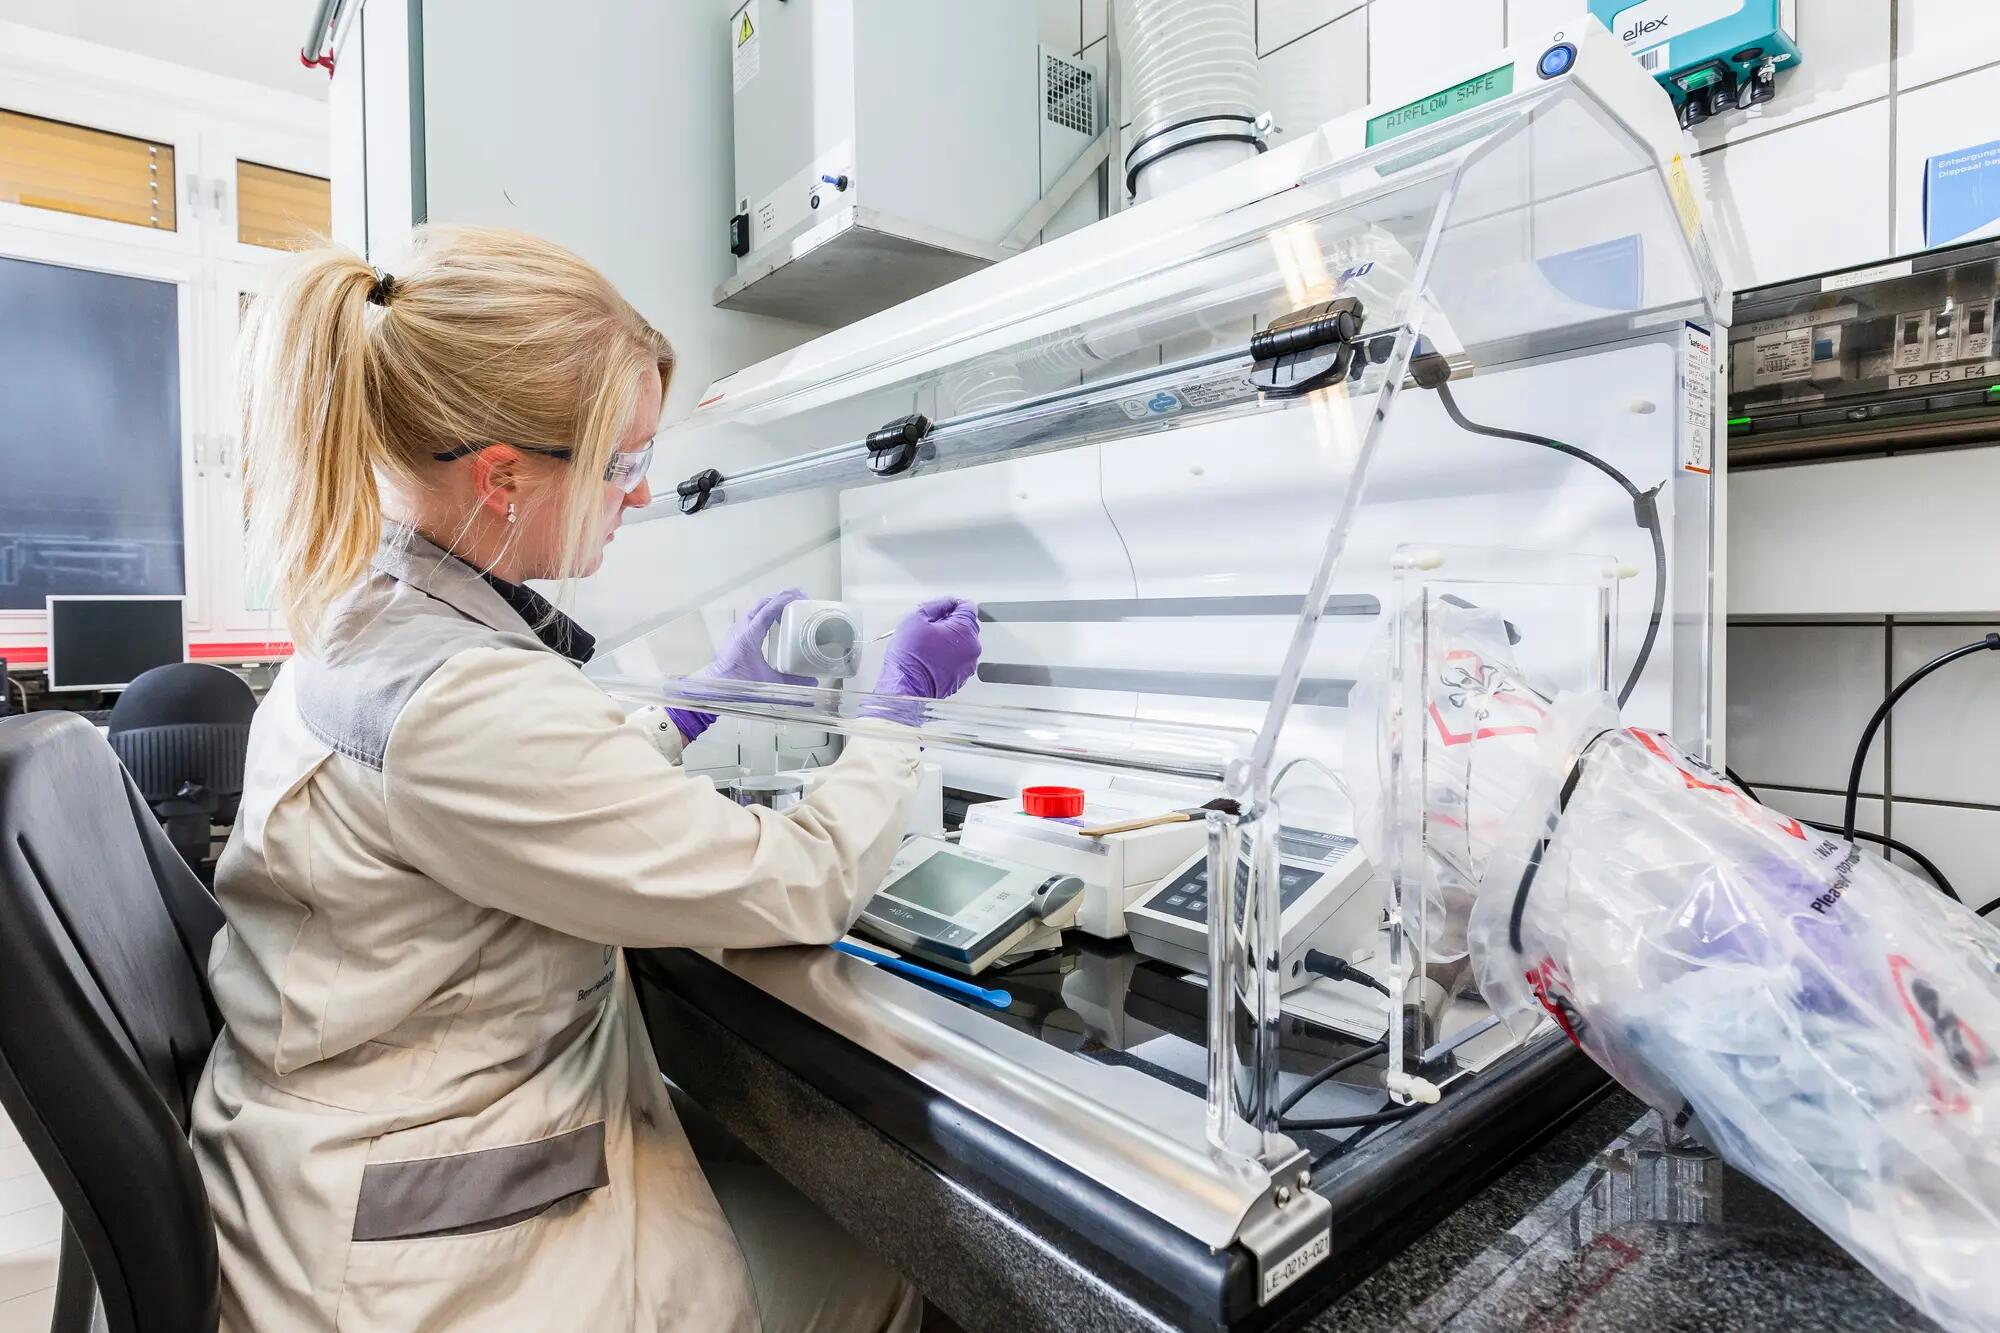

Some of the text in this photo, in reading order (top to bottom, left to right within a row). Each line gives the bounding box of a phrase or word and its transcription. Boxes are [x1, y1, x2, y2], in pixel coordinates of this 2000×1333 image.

[1623, 14, 1669, 41] eltex
[1386, 76, 1494, 129] AIRFLOW SAFE
[1898, 365, 1986, 387] F2 F3 F4
[1266, 1236, 1329, 1294] LE-0213-021
